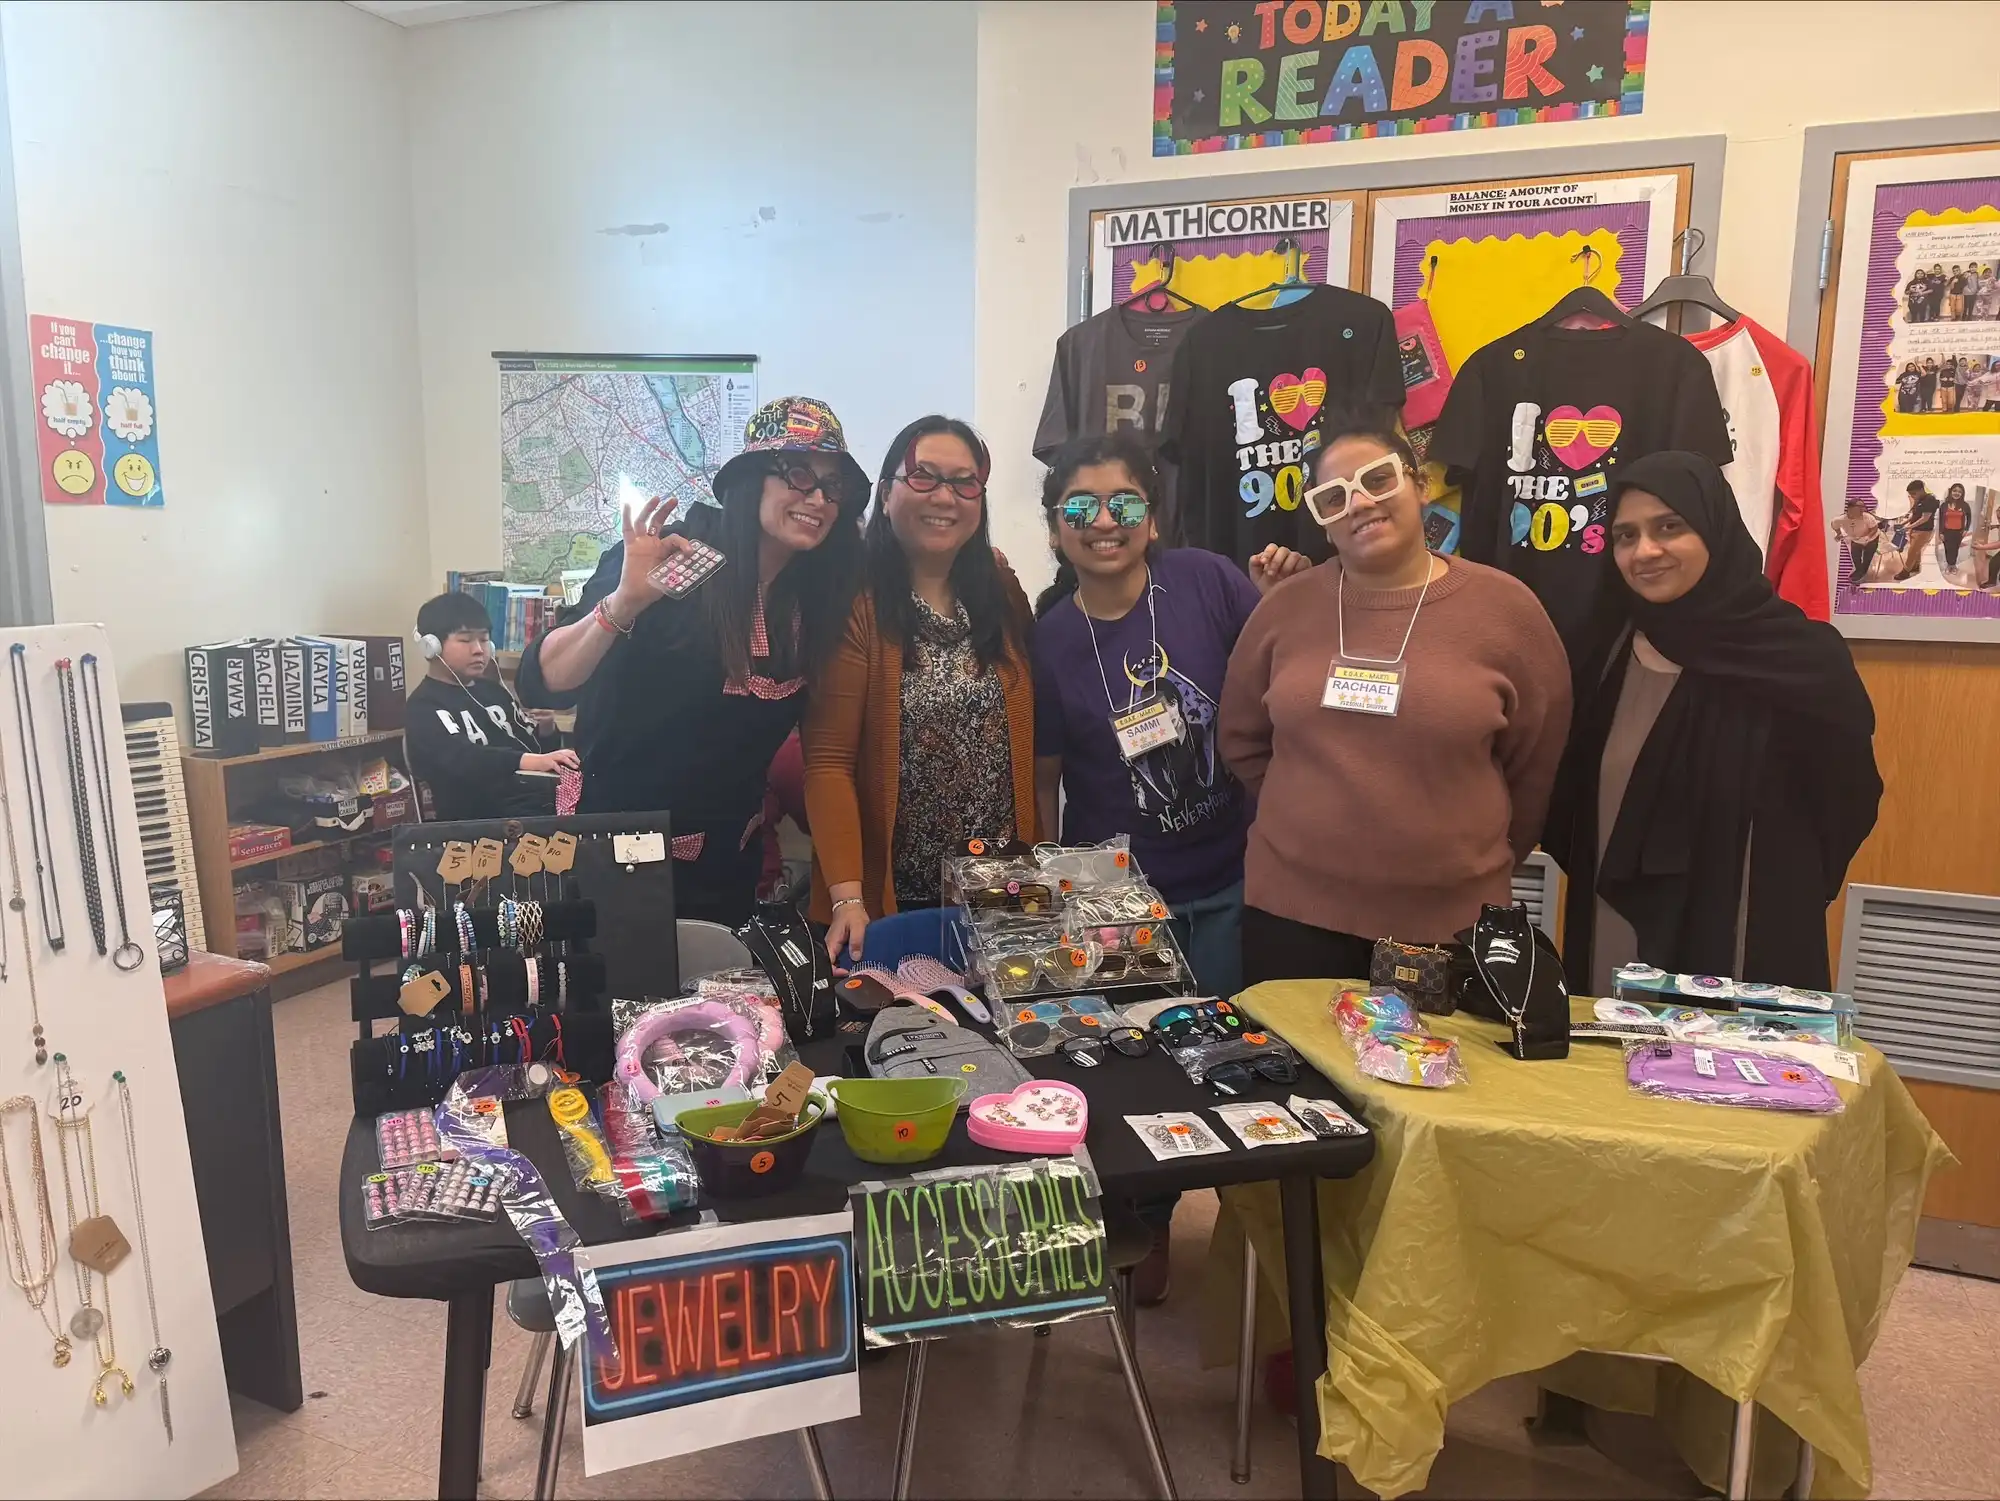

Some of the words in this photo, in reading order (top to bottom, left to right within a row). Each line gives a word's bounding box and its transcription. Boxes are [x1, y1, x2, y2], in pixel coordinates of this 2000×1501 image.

[1254, 0, 1436, 49] TODAY
[1219, 24, 1566, 127] READER
[1450, 190, 1507, 202] BALANCE:
[1509, 186, 1560, 197] AMOUNT
[1562, 184, 1578, 193] OF
[1449, 203, 1490, 213] MONEY
[1492, 202, 1504, 210] IN
[1508, 198, 1540, 209] YOUR
[1543, 195, 1593, 207] ACOUNT
[1110, 207, 1202, 243] MATH
[1208, 200, 1327, 235] CORNER
[59, 324, 76, 336] you
[54, 335, 76, 347] can't
[40, 342, 90, 364] change
[108, 354, 146, 373] think
[112, 370, 137, 382] about
[762, 409, 783, 423] THE
[1227, 377, 1265, 445] I
[1506, 402, 1542, 473] I
[1235, 438, 1302, 471] THE
[1507, 475, 1570, 501] THE
[389, 644, 404, 690] LEAH
[314, 651, 328, 705] KAYLA
[336, 660, 348, 703] LADY
[353, 646, 367, 720] SAMARA
[1332, 680, 1394, 696] RACHAEL
[191, 653, 211, 744] CRISTINA
[284, 652, 303, 728] JAZMINE
[1126, 718, 1160, 738] SAMMI
[240, 841, 282, 856] Sentences
[450, 856, 467, 869] 5
[1140, 932, 1148, 940] 15
[1074, 952, 1084, 962] 15
[60, 1094, 82, 1112] 20
[772, 1091, 792, 1106] 5
[758, 1158, 767, 1168] 5
[599, 1256, 838, 1391] JEWELRY
